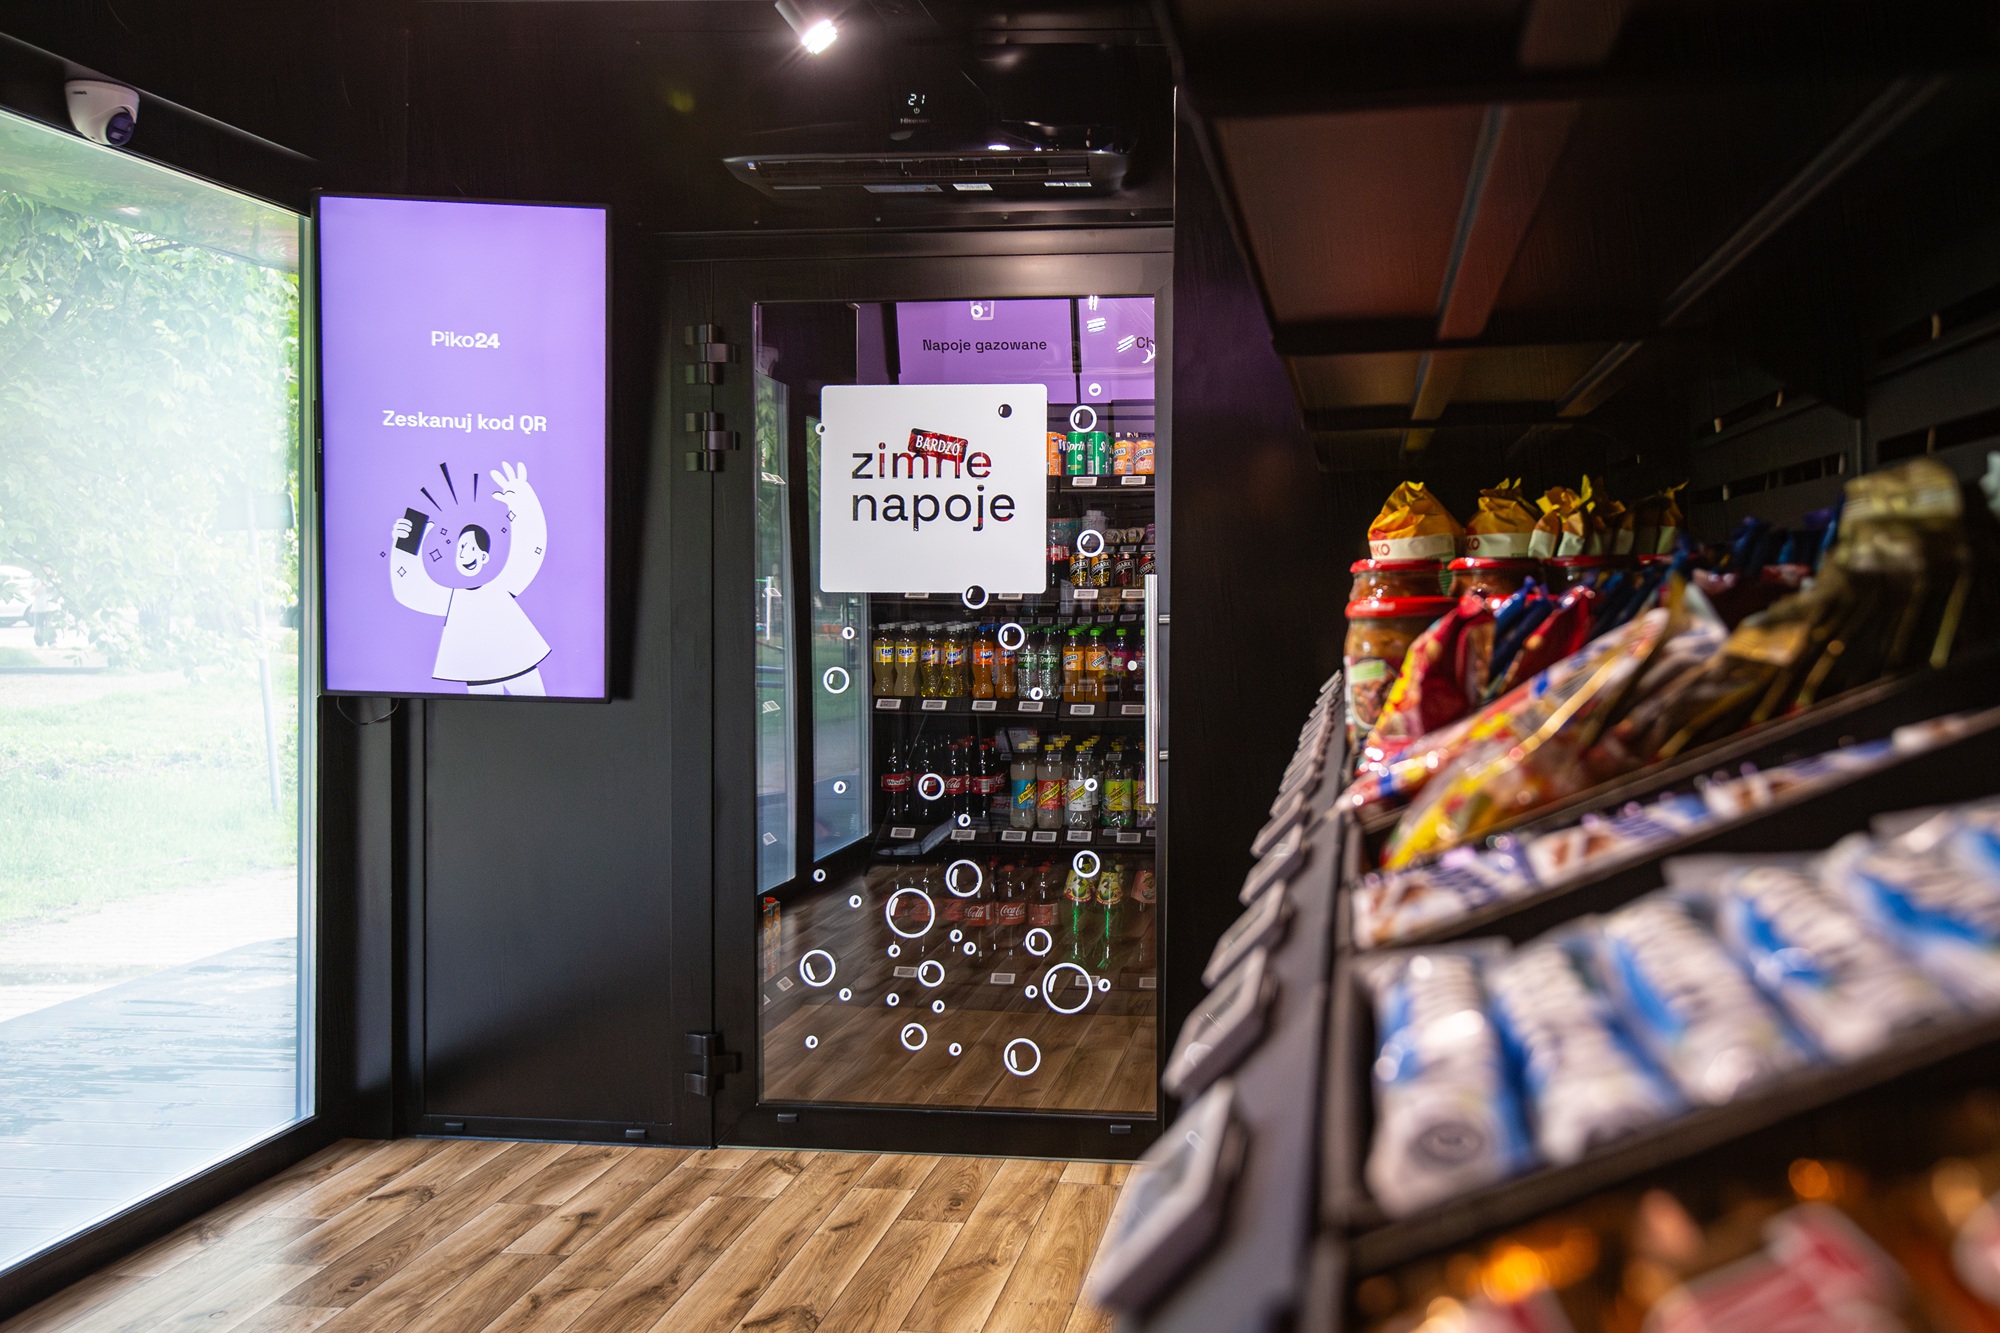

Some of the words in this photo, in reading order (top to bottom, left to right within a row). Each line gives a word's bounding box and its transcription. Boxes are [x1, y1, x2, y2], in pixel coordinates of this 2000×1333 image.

[907, 93, 926, 106] 21
[430, 330, 501, 349] Piko24
[922, 339, 971, 354] Napoje
[975, 340, 1047, 354] gazowane
[382, 409, 473, 434] Zeskanuj
[477, 413, 514, 431] kod
[519, 414, 547, 435] QR
[915, 434, 961, 457] BARDZO
[851, 441, 992, 480] zimne
[852, 484, 1016, 532] napoje
